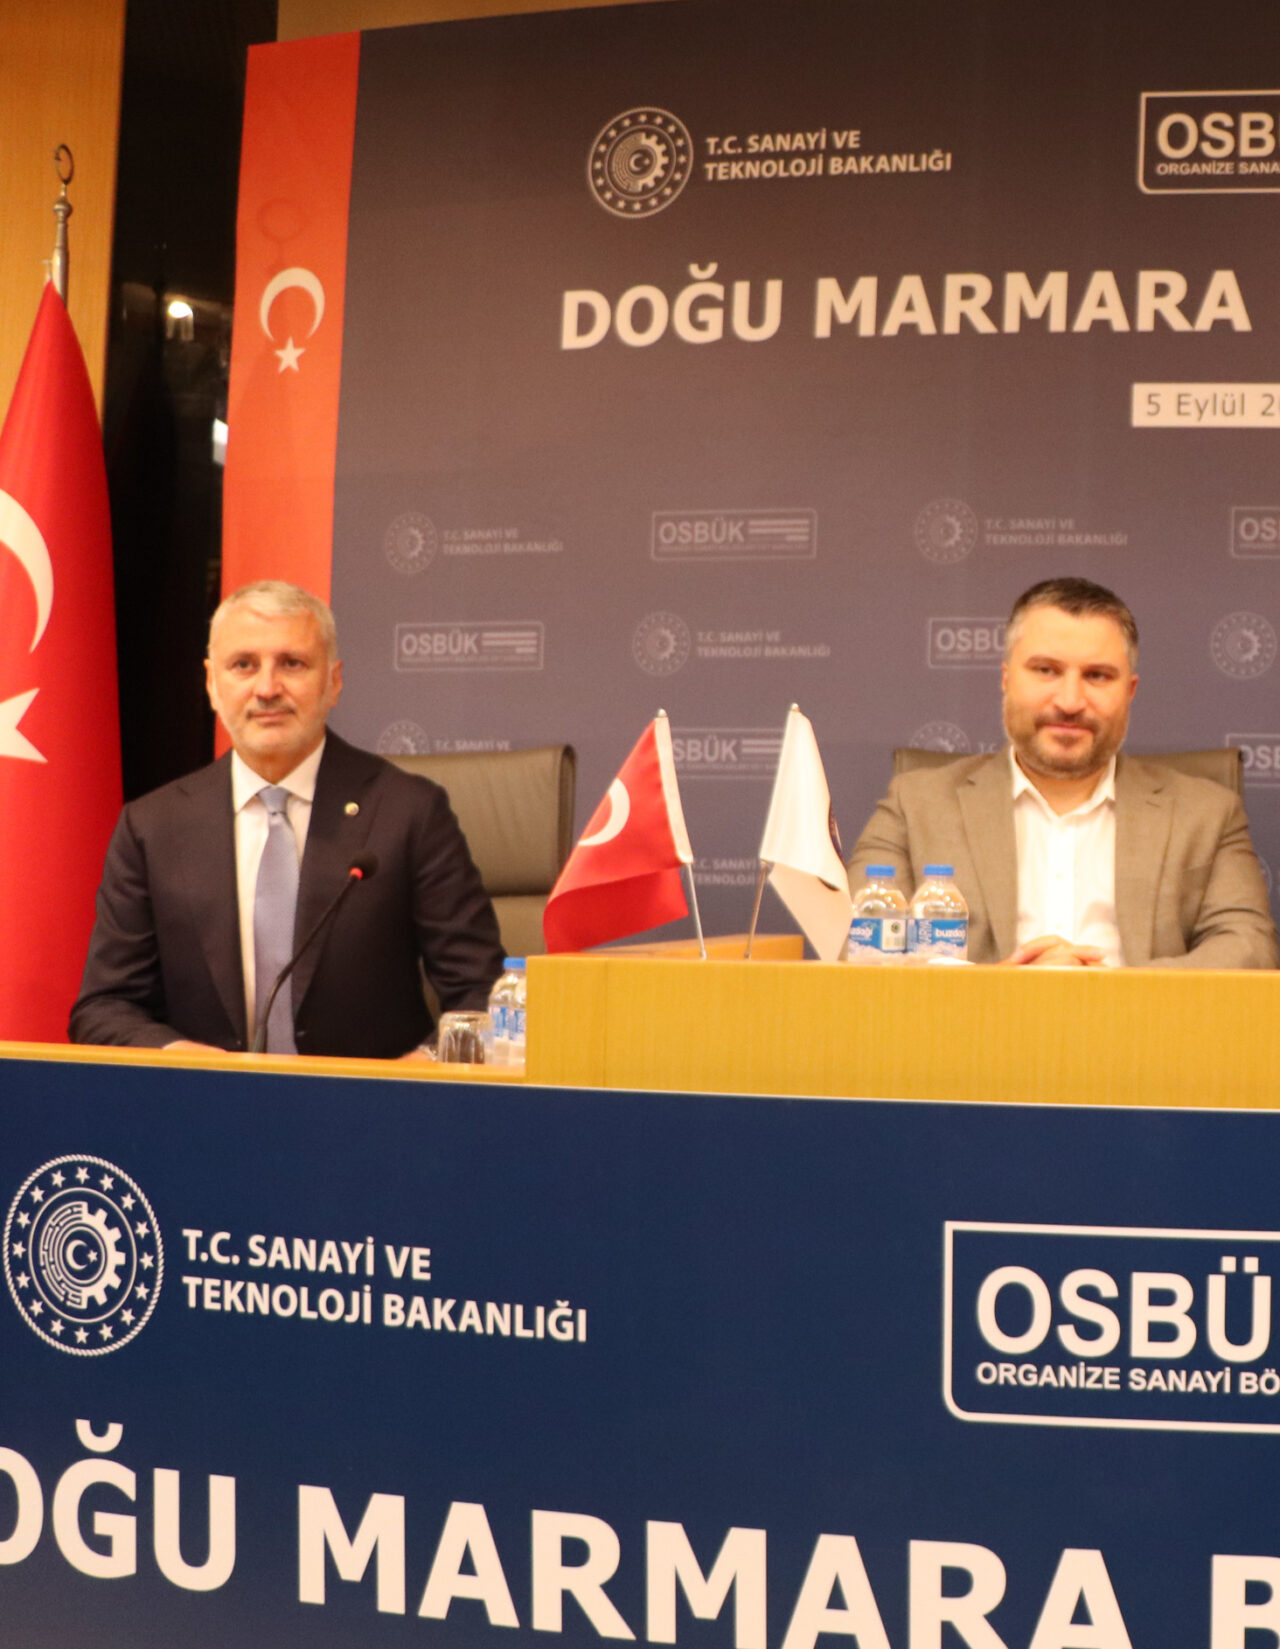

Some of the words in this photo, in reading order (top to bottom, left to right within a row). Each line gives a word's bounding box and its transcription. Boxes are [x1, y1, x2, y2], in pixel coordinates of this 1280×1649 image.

[706, 135, 742, 155] T.C.
[746, 127, 826, 154] SANAYİ
[832, 130, 861, 149] VE
[704, 154, 823, 181] TEKNOLOJİ
[829, 148, 952, 176] BAKANLIĞI
[1156, 161, 1234, 176] ORGANİZE
[560, 262, 783, 350] DOĞU
[813, 269, 1252, 339] MARMARA
[1146, 394, 1162, 416] 5
[1176, 393, 1246, 422] Eylül
[659, 516, 745, 544] OSBÜK
[401, 627, 479, 656] OSBÜK
[936, 624, 1009, 652] OSBÜ
[672, 735, 738, 762] SBÜK
[182, 1228, 239, 1266] T.C.
[248, 1236, 374, 1275] SANAYİ
[385, 1245, 431, 1281] VE
[182, 1275, 372, 1324] TEKNOLOJİ
[384, 1293, 587, 1343] BAKANLIĞI
[976, 1362, 1121, 1390] ORGANİZE
[1128, 1367, 1231, 1393] SANAYİ
[298, 1484, 1136, 1649] MARMARA
